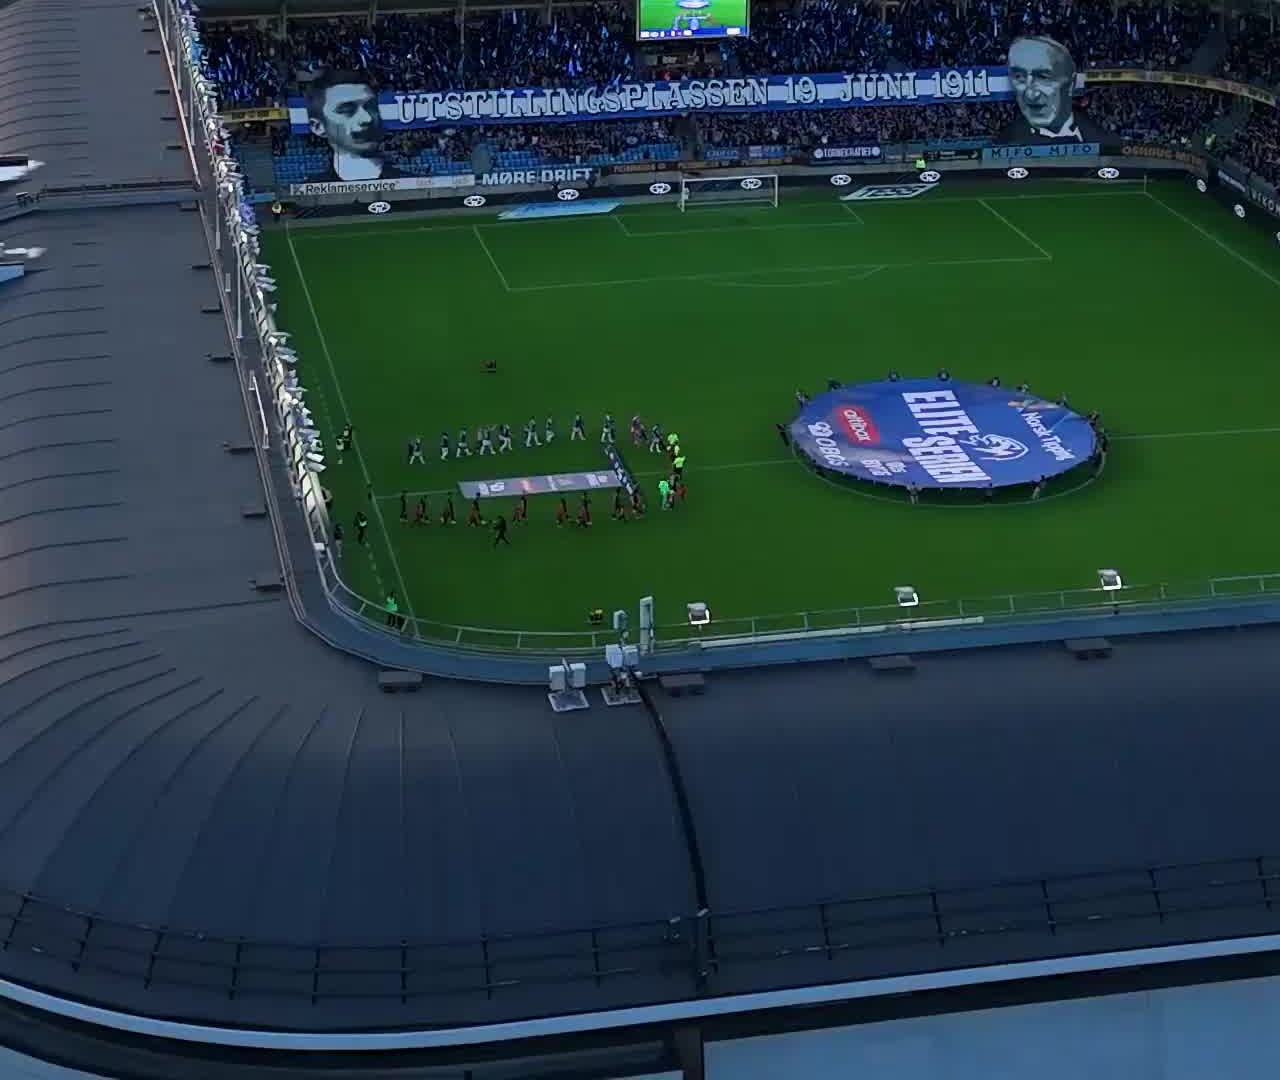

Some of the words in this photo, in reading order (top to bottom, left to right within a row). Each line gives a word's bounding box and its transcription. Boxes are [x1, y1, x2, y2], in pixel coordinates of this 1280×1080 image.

[394, 78, 768, 124] UTSTILLINGSPLASSEN
[784, 76, 824, 104] 19.
[838, 72, 918, 103] JUNI
[931, 69, 991, 99] 1911
[306, 181, 396, 195] Reklameservice
[482, 169, 536, 185] MØRE
[541, 167, 594, 182] DRIFT
[901, 389, 980, 436] ELITE
